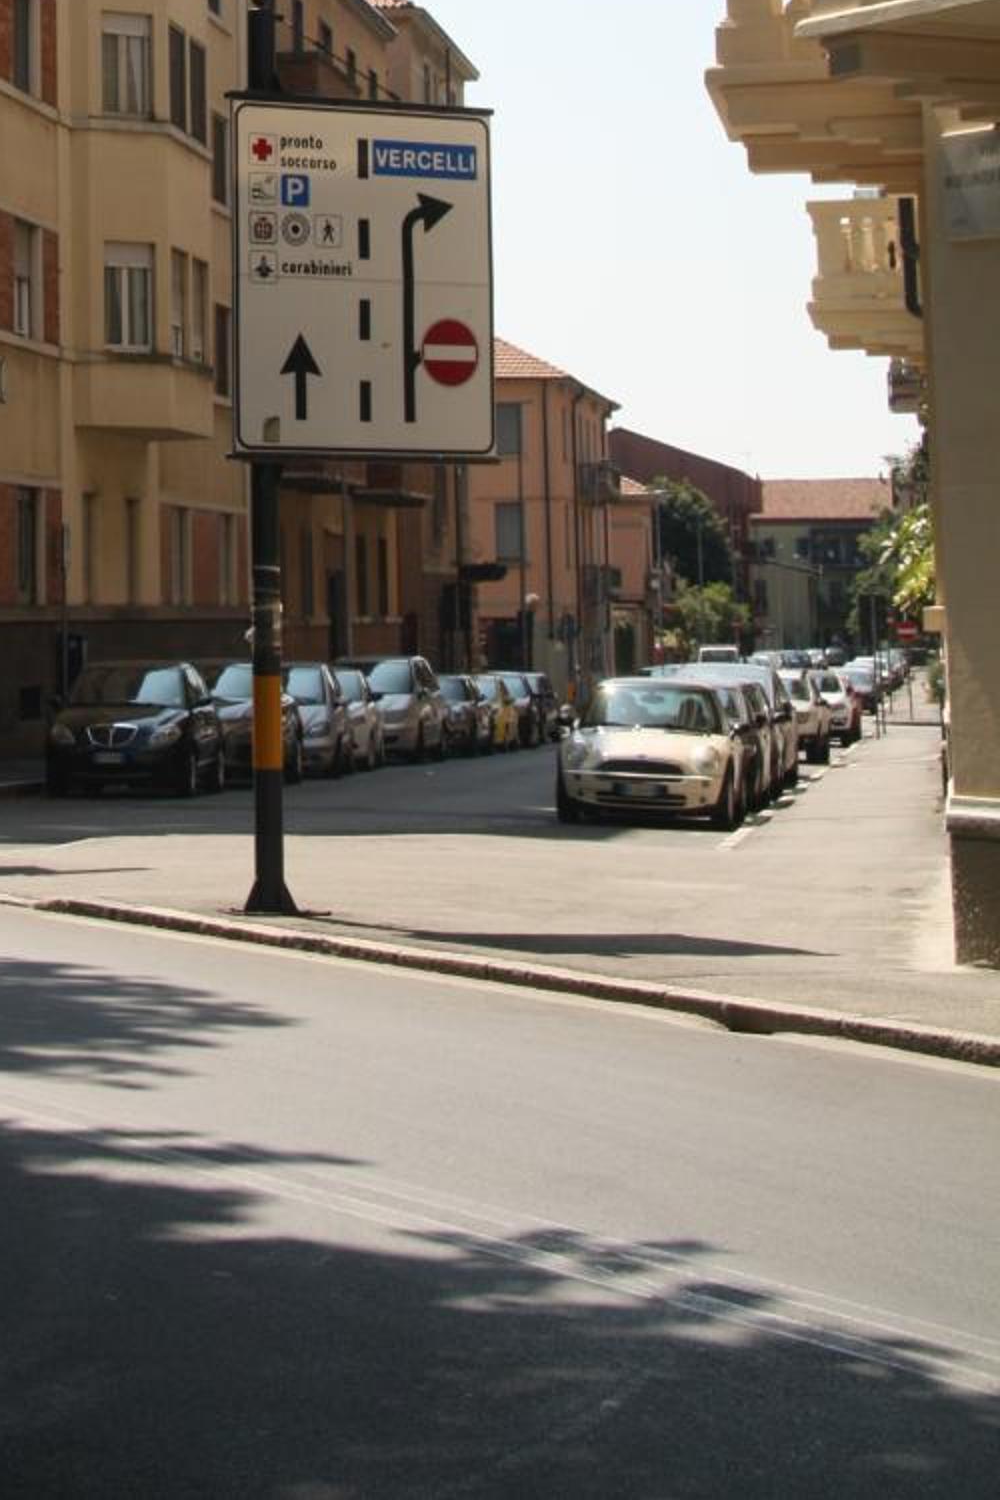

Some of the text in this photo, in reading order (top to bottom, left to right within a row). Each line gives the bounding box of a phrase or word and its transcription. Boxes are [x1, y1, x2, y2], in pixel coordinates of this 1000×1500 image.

[280, 135, 323, 151] pronto
[280, 156, 338, 171] soccorso
[375, 148, 475, 173] VERCELLI
[288, 177, 304, 204] P
[281, 259, 354, 277] carabinieri
